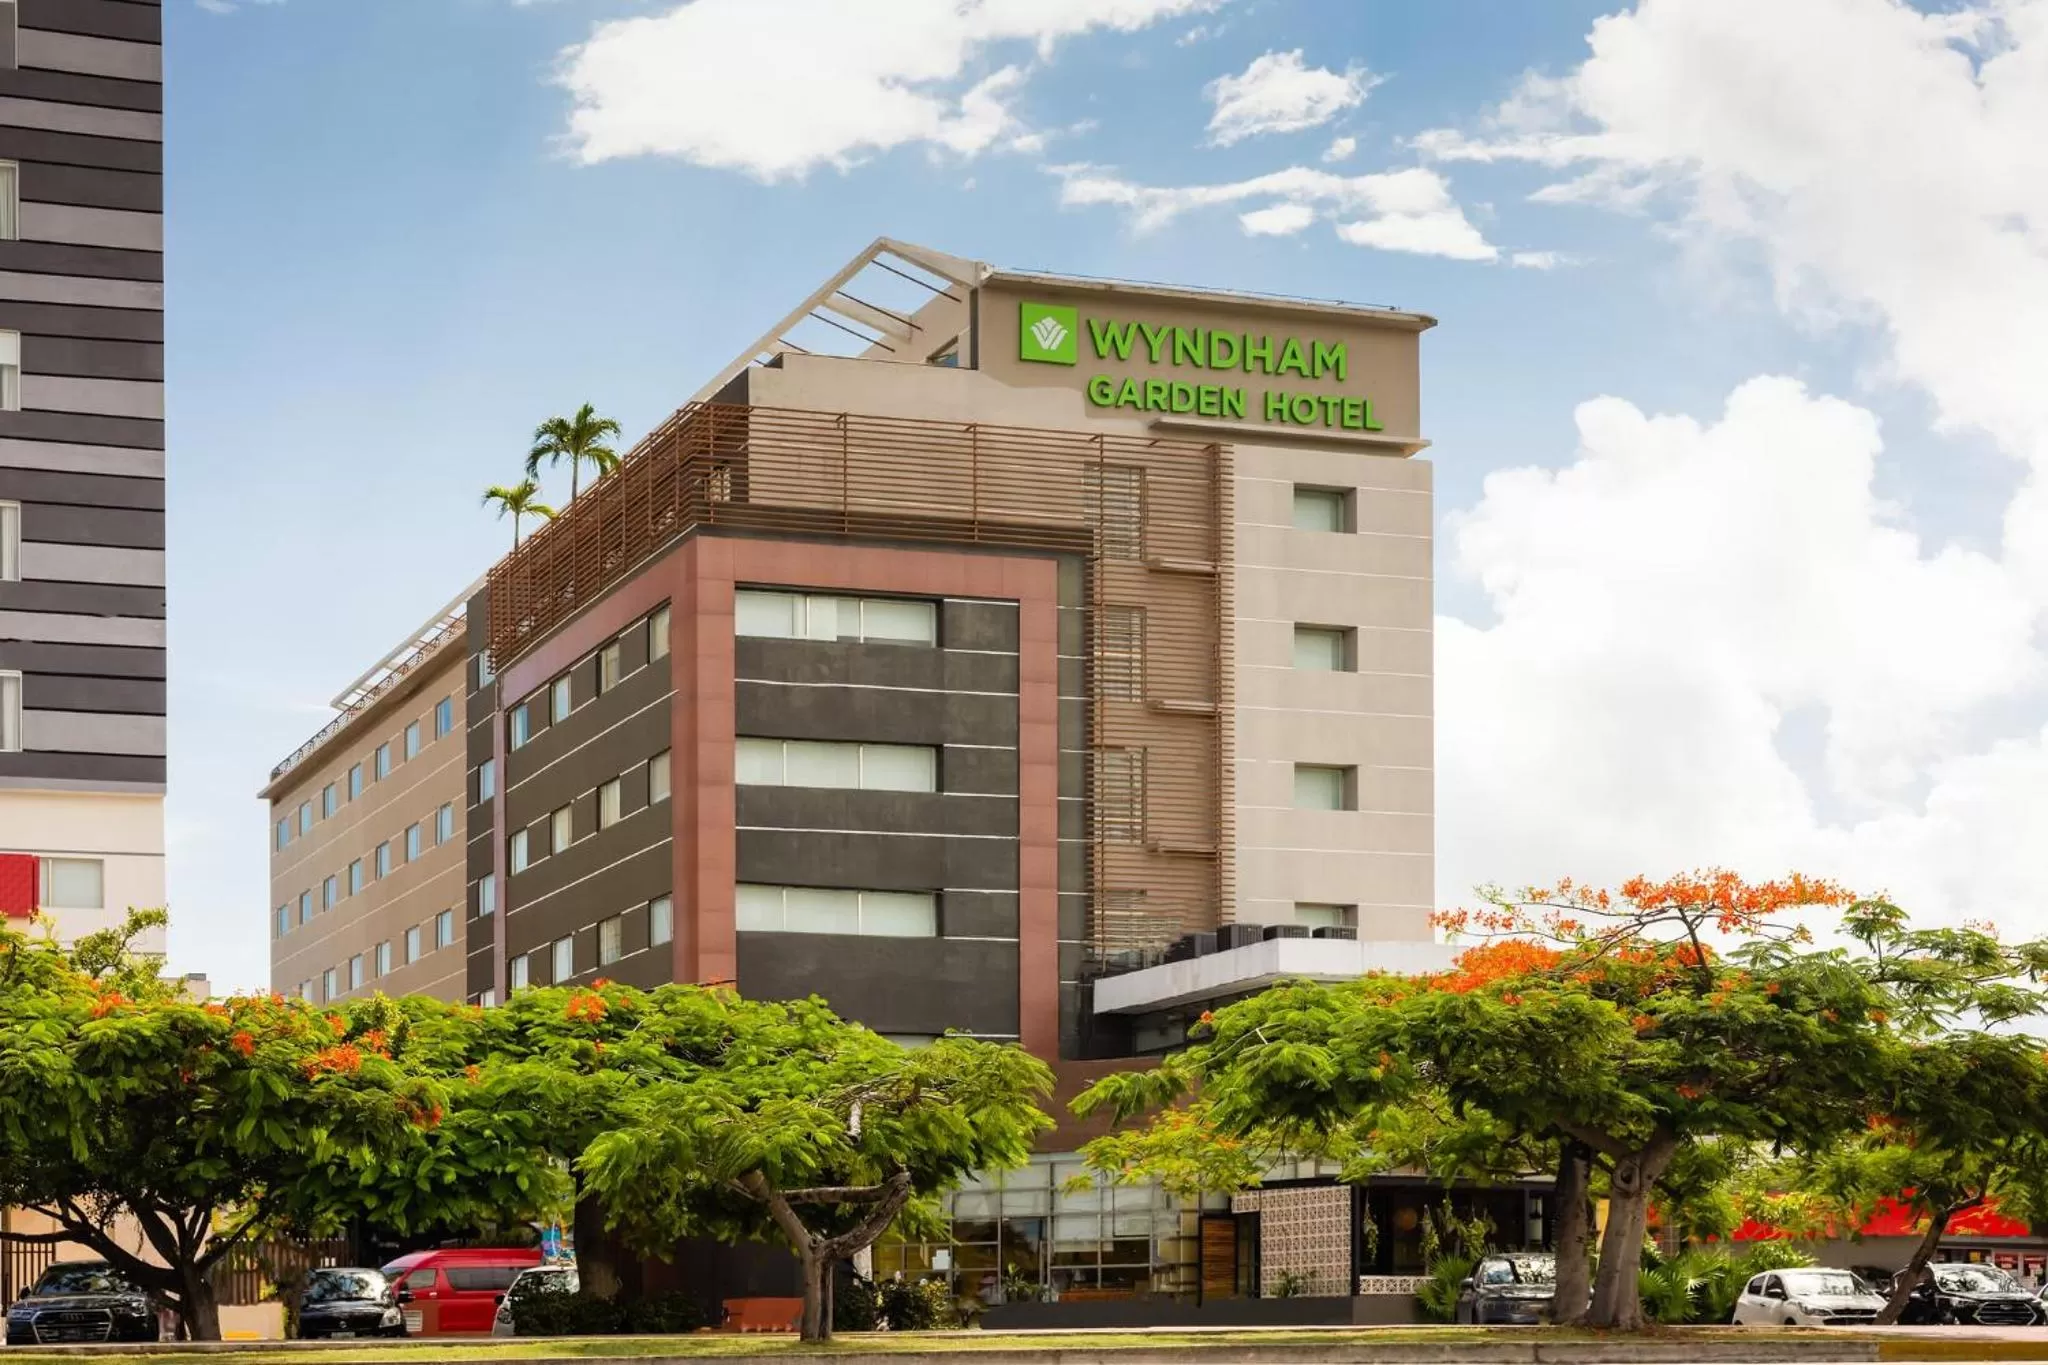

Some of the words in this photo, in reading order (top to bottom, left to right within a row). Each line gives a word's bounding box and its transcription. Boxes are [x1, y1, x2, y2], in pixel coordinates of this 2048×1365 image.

[1088, 318, 1348, 381] WYNDHAM
[1088, 375, 1247, 418] GARDEN
[1264, 391, 1384, 431] HOTEL
